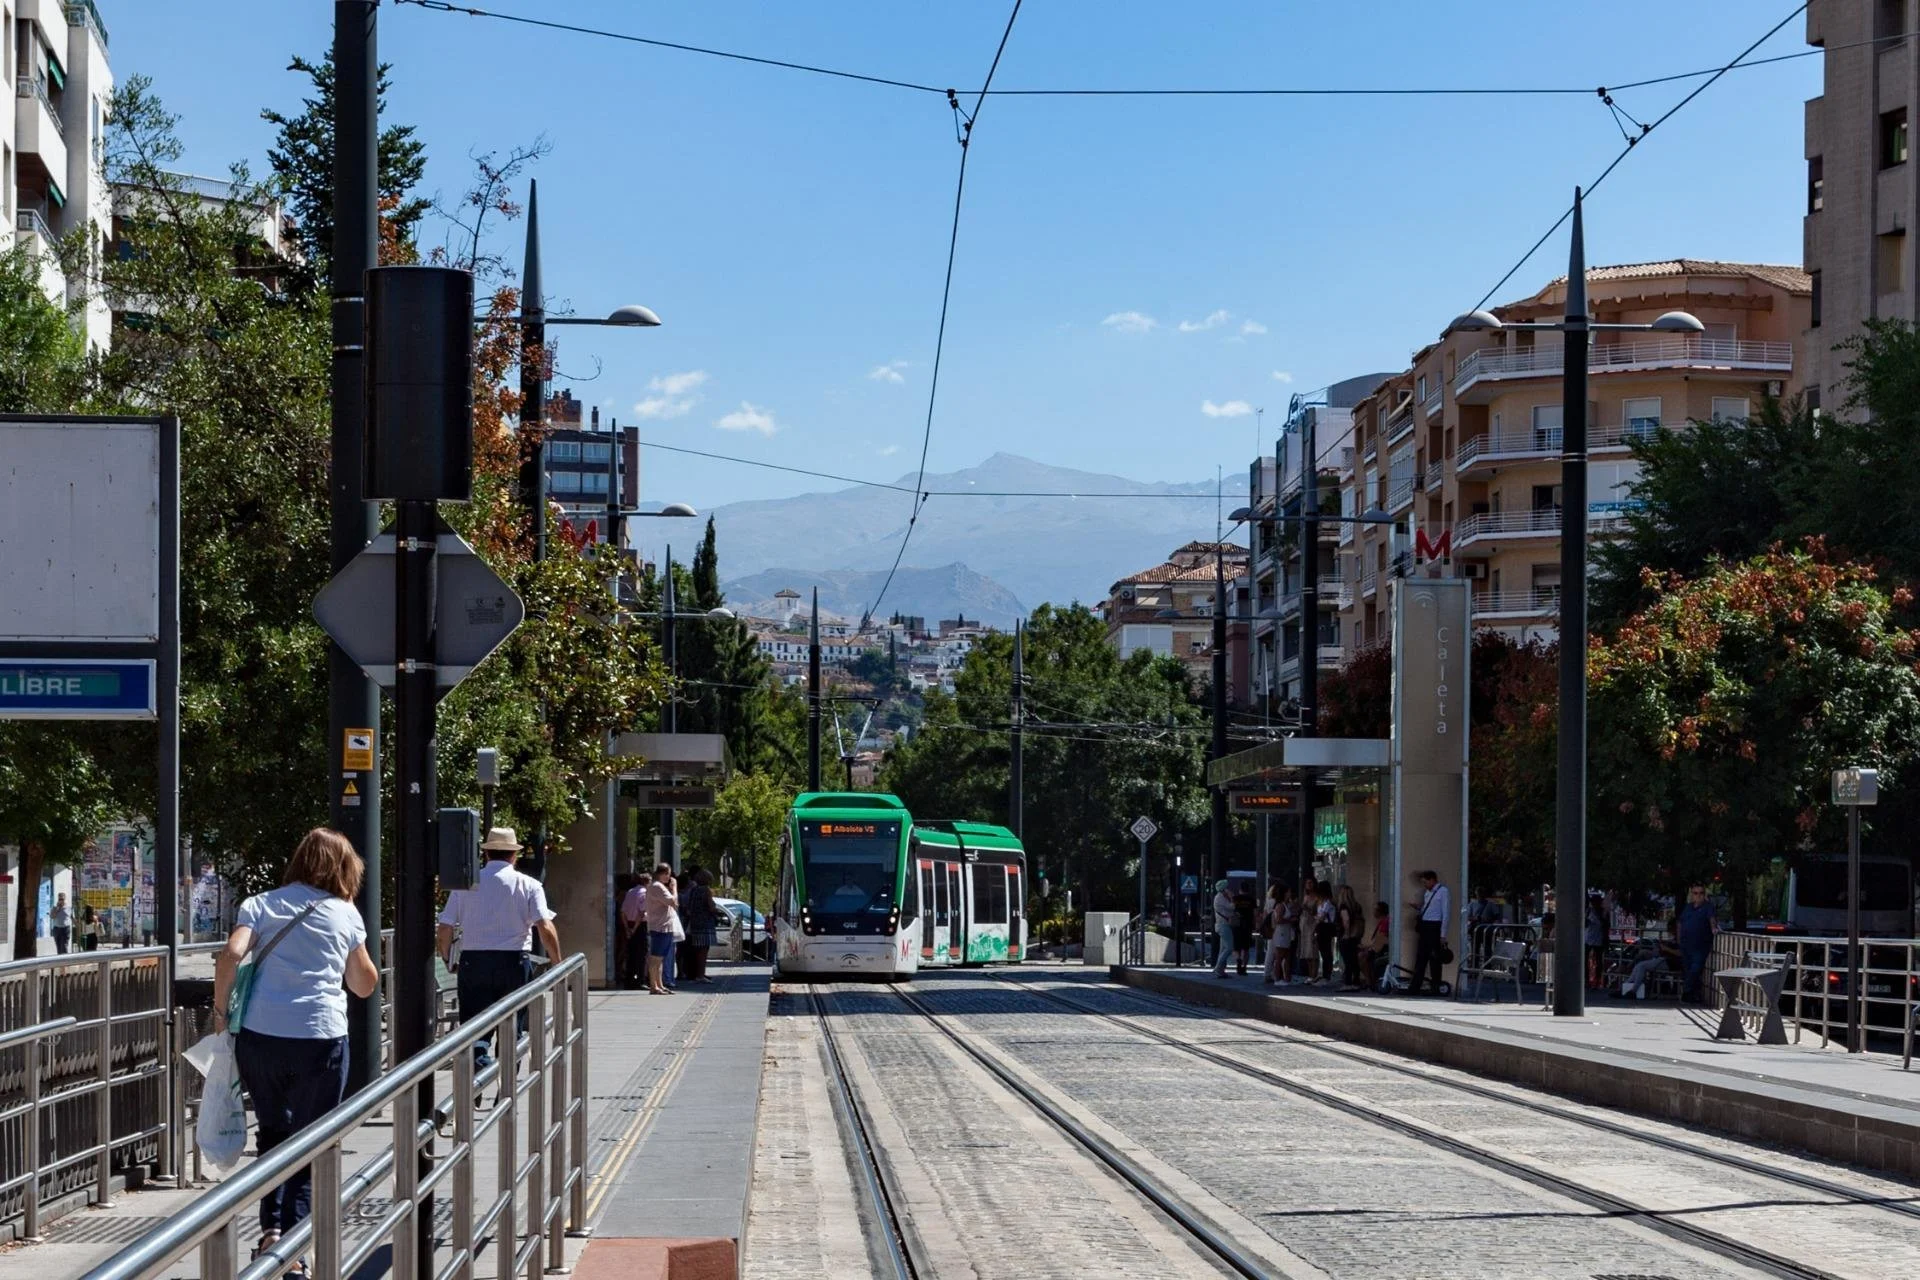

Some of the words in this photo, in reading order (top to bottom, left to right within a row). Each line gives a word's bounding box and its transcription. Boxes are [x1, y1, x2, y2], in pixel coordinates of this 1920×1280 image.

[1415, 528, 1451, 560] M
[1, 676, 82, 695] LIBRE
[1436, 626, 1449, 734] Caleta
[833, 825, 863, 833] Albolote
[864, 825, 875, 833] V2
[1138, 824, 1151, 834] 20
